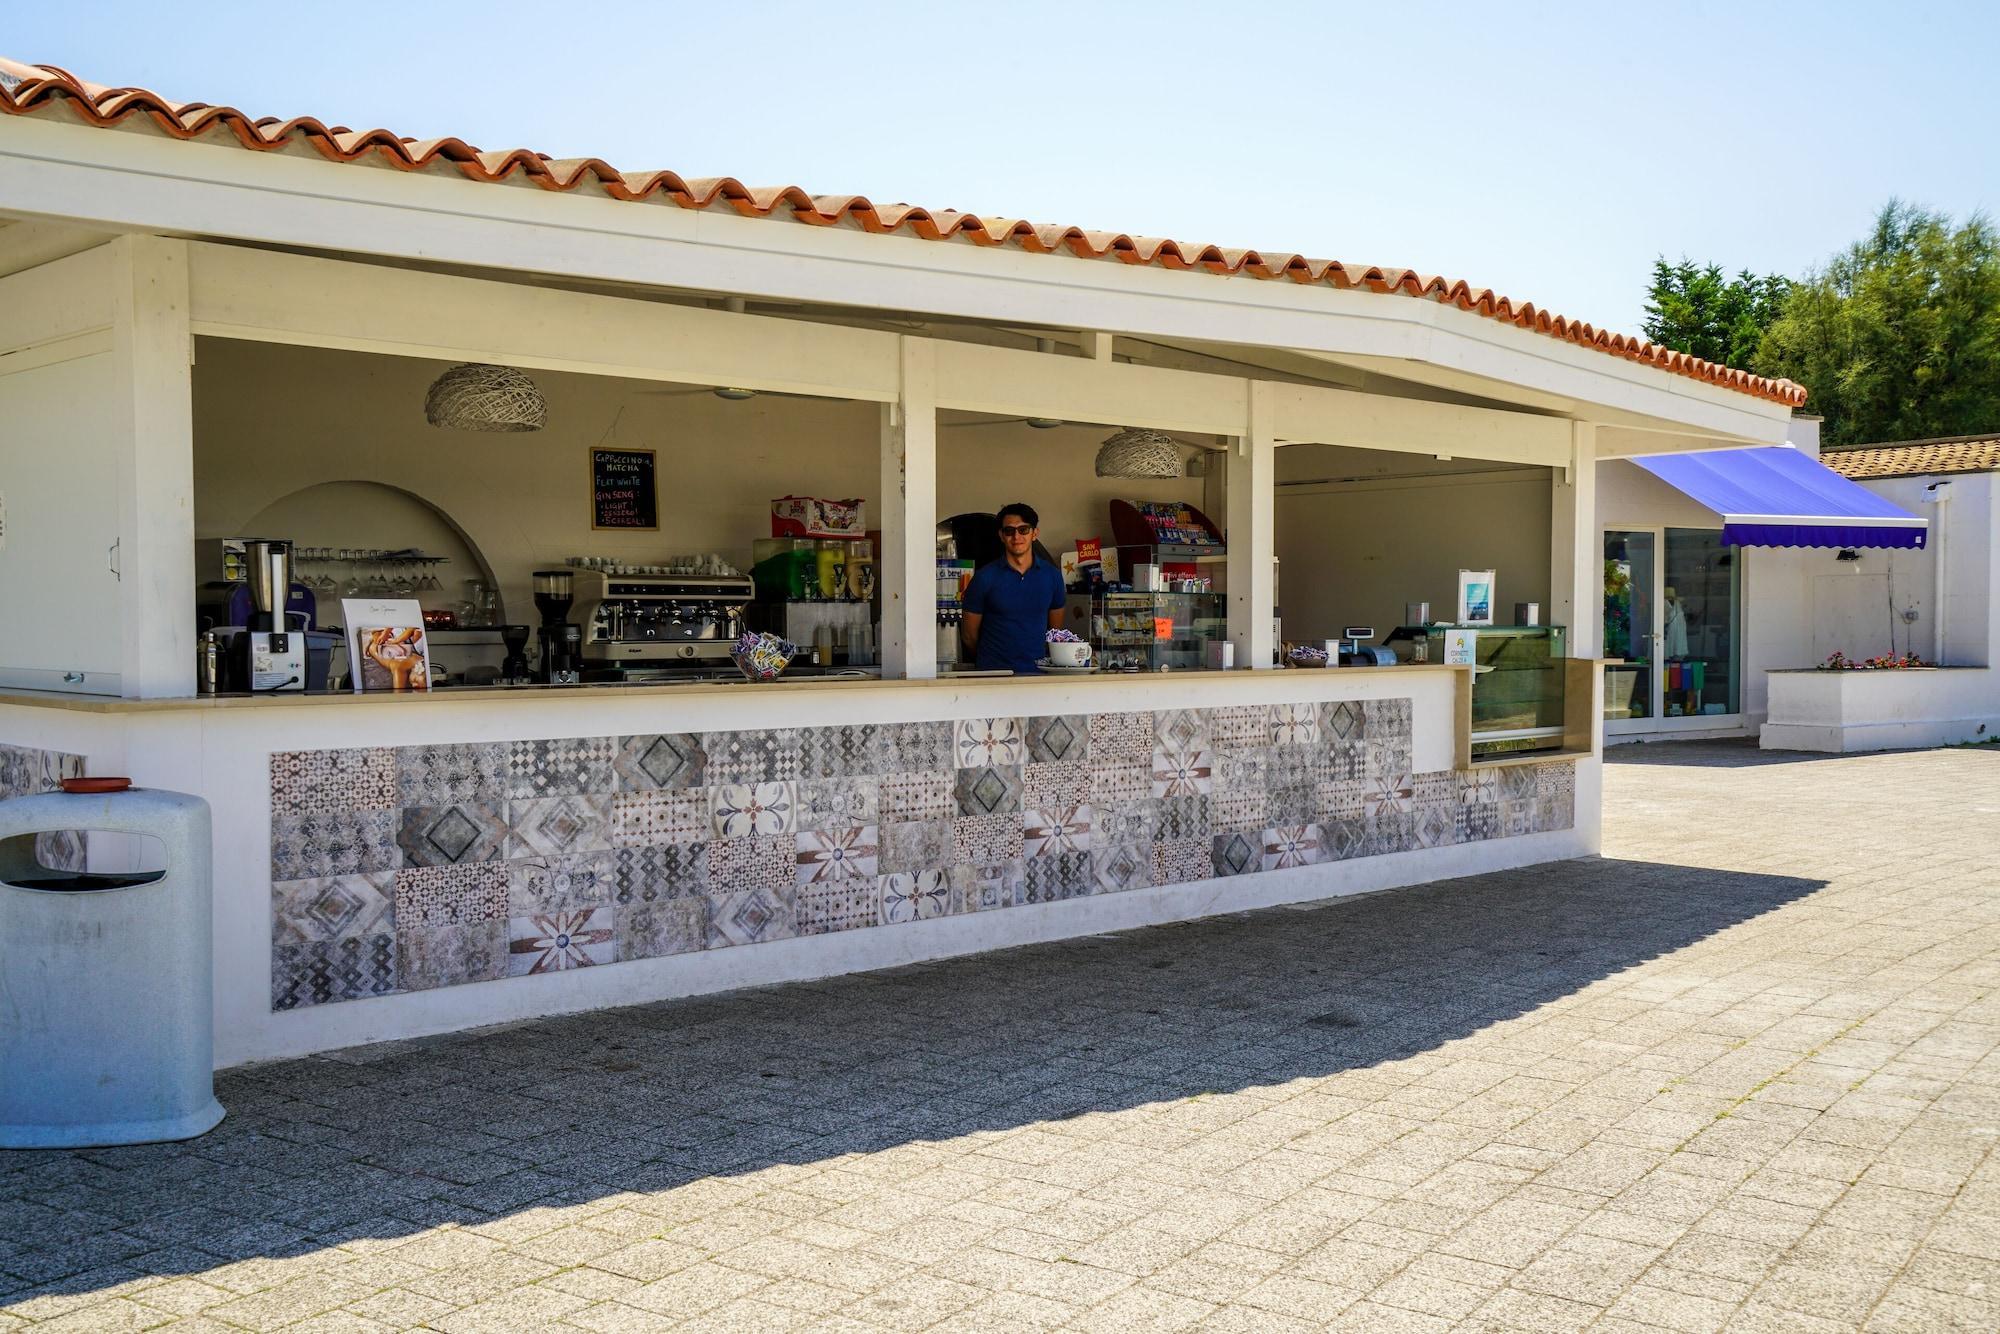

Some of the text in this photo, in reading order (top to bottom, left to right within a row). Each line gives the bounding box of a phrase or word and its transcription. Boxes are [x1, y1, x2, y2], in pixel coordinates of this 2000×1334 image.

[596, 453, 642, 464] CAPPUCCINO
[606, 464, 639, 472] MATCHA
[596, 475, 640, 487] FLAT WHITE
[1082, 543, 1095, 551] SAN
[1079, 549, 1099, 558] CARLO
